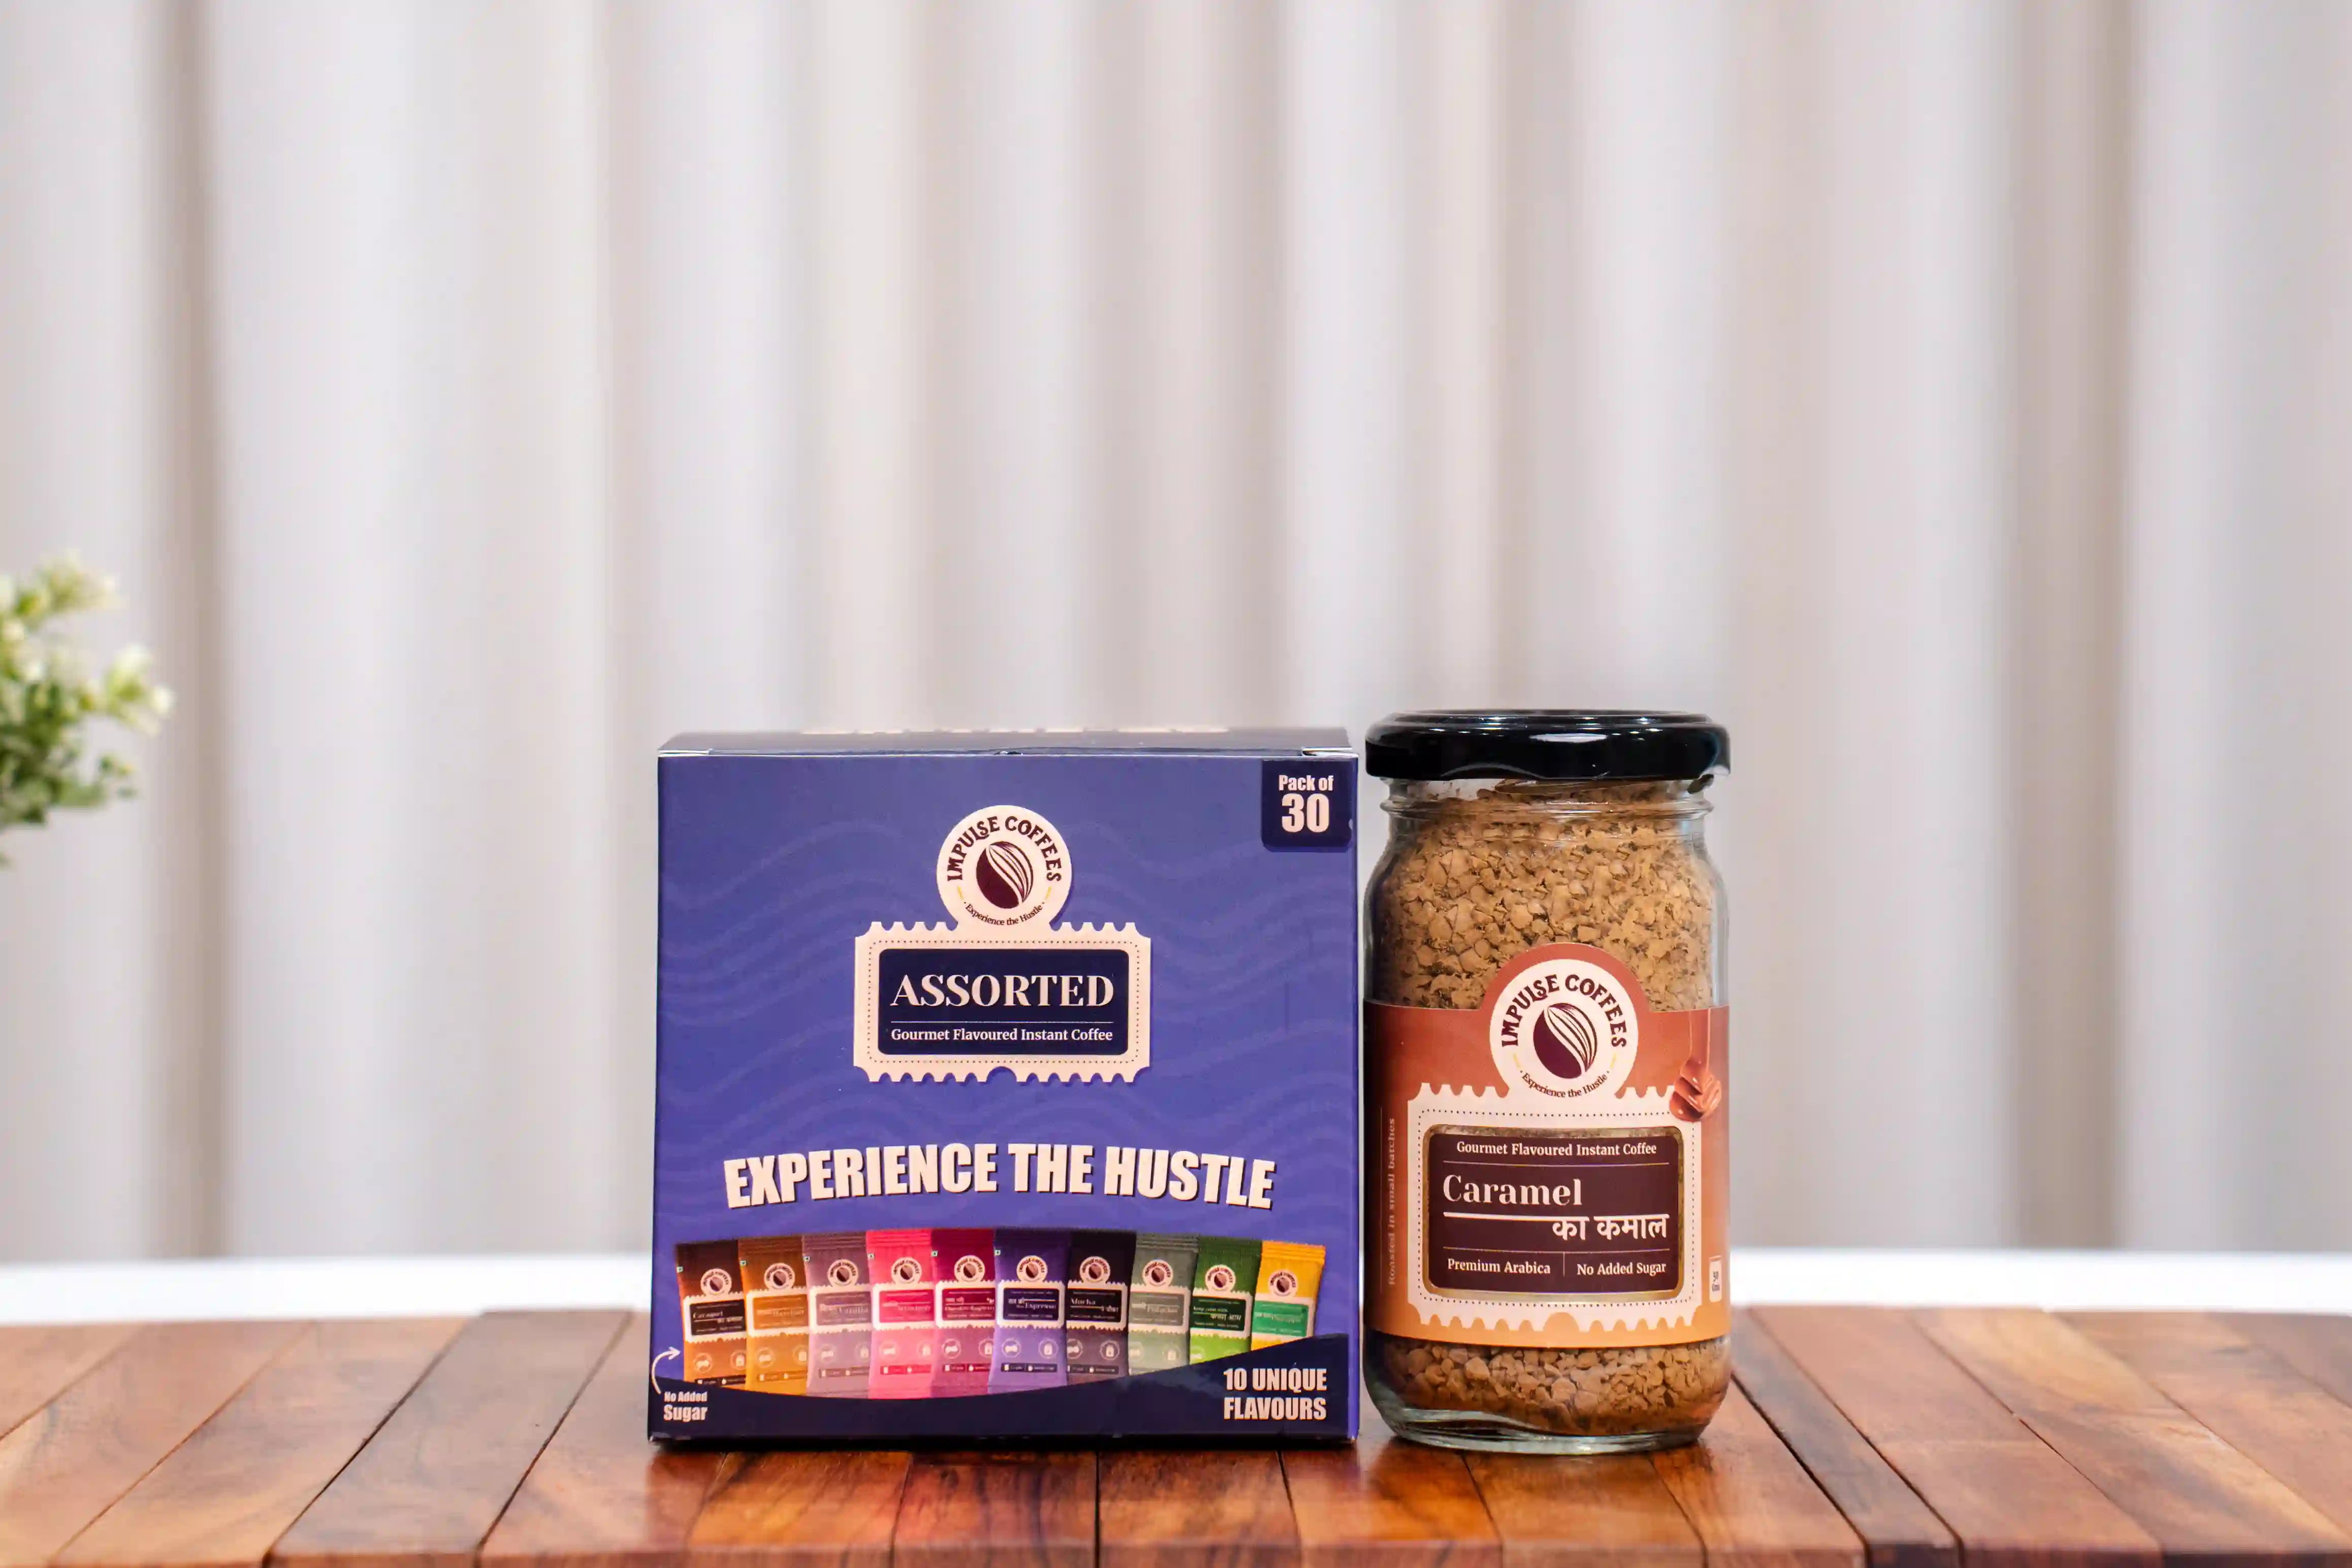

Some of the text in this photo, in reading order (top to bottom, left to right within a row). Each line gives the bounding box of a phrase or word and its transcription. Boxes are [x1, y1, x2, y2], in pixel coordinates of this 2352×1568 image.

[1279, 775, 1334, 791] Pack of
[1282, 793, 1329, 832] 30
[947, 816, 1062, 881] IMPULSE COFFEES
[966, 904, 1043, 925] Experience the Hustle
[890, 974, 1114, 1006] ASSORTED
[1501, 974, 1627, 1048] IMPULSE COFFEES
[891, 1029, 1113, 1040] Gourmet Flavoured Instant Coffee
[1522, 1072, 1608, 1098] Experience the Hustle
[1457, 1141, 1657, 1156] Gourmet Flavoured Instant Coffee
[724, 1143, 1276, 1210] EXPERIENCE THE HUSTLE
[1443, 1174, 1582, 1206] Caramel
[1552, 1214, 1670, 1240] का कमाल
[1448, 1258, 1551, 1274] Premium Arabica
[1577, 1262, 1666, 1276] No Added Sugar
[1223, 1368, 1327, 1393] 10 UNIQUE
[664, 1391, 708, 1402] No Added
[1223, 1396, 1326, 1420] FLAVOURS
[663, 1404, 708, 1422] Sugar
